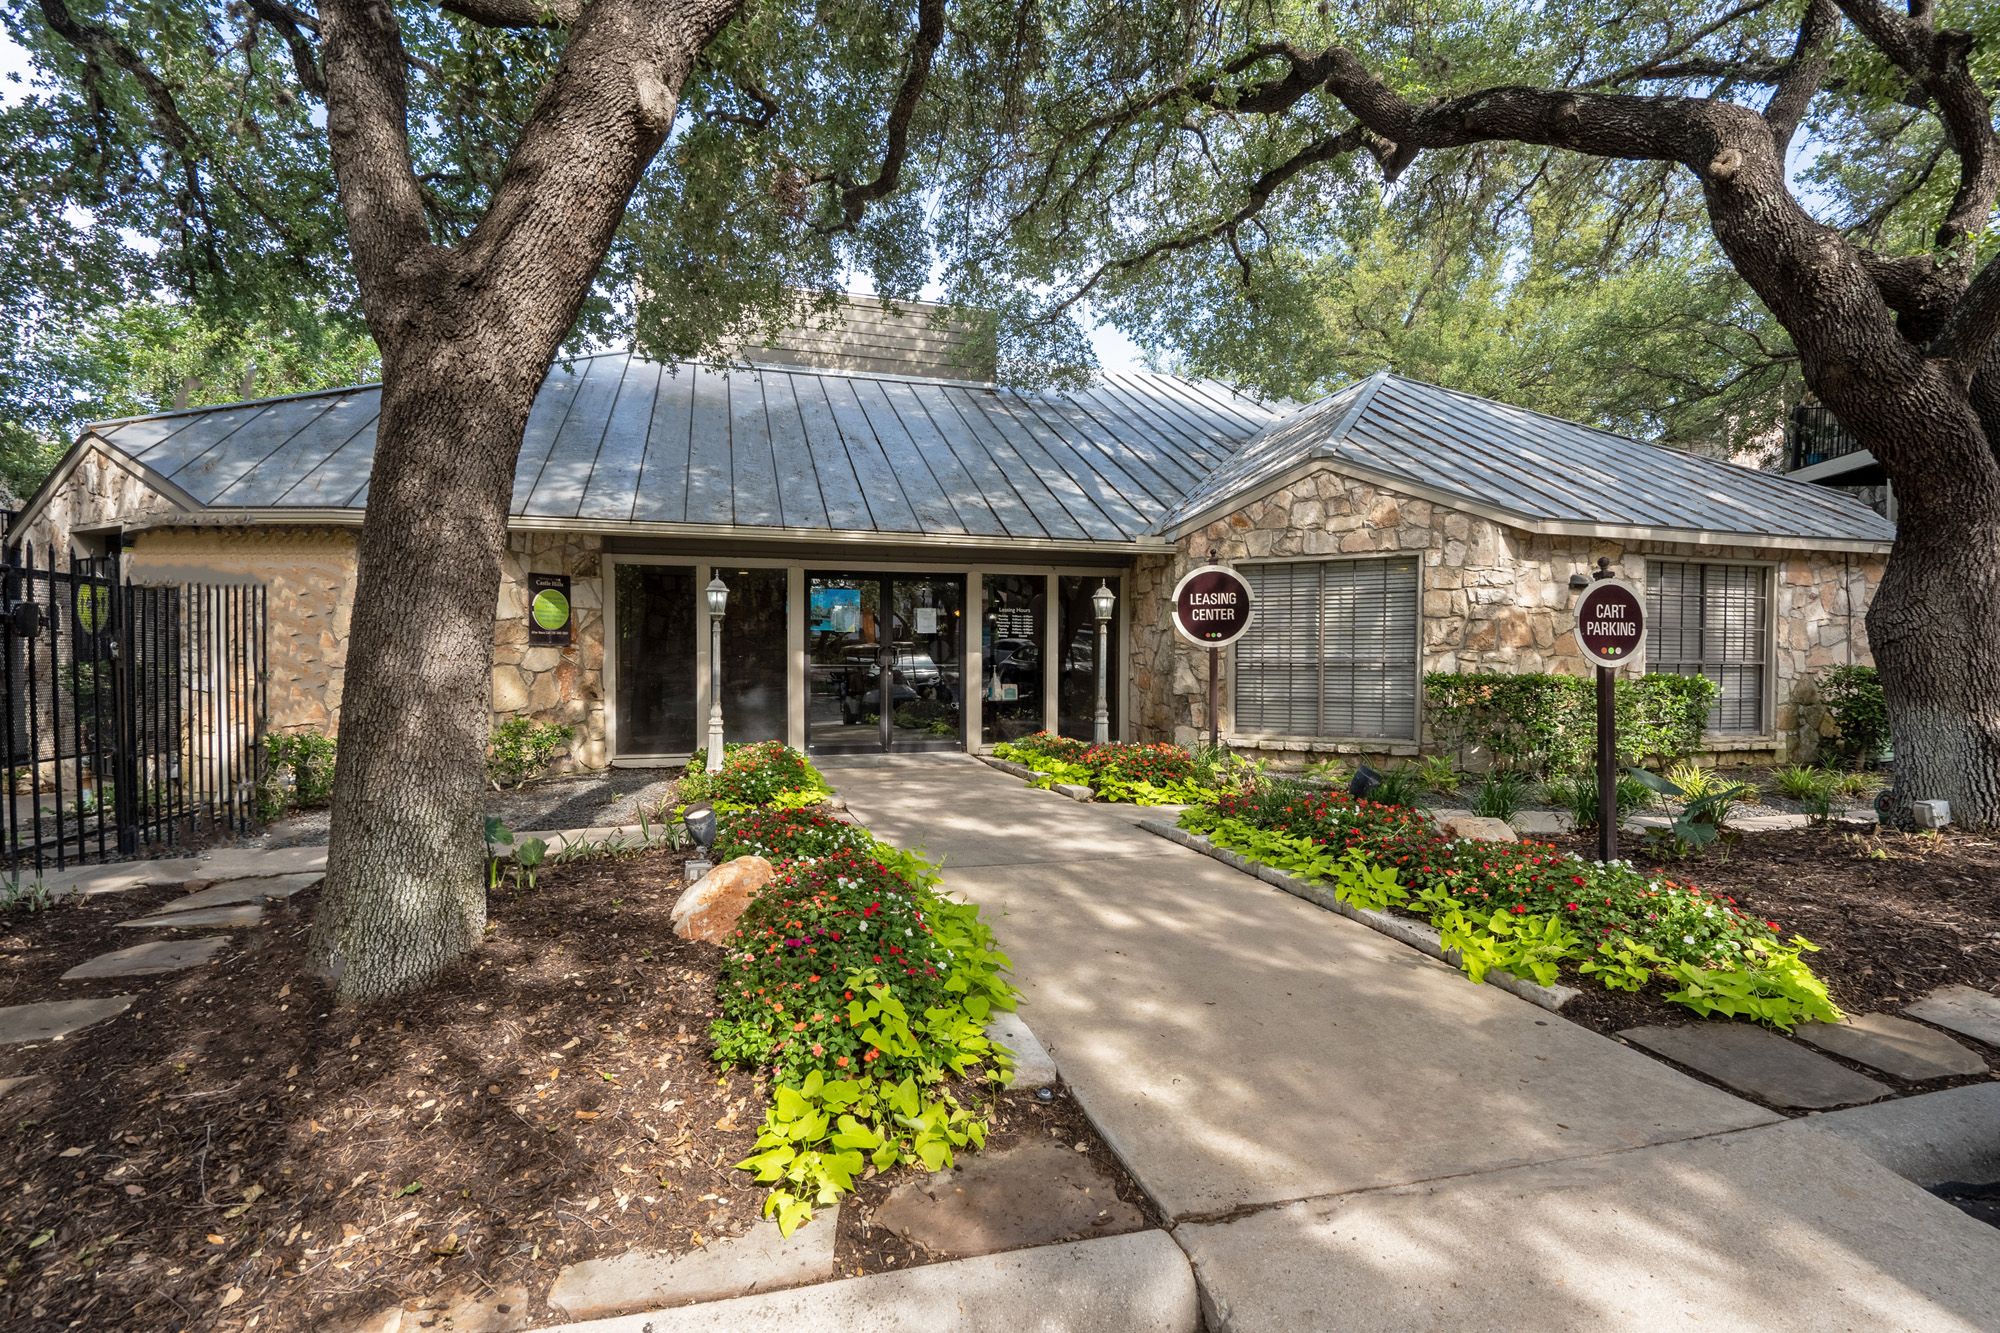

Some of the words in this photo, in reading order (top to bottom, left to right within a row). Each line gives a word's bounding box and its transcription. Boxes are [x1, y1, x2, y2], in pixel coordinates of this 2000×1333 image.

[1190, 592, 1237, 605] LEASING
[1192, 608, 1235, 621] CENTER
[1596, 604, 1627, 619] CART
[1587, 621, 1636, 636] PARKING
